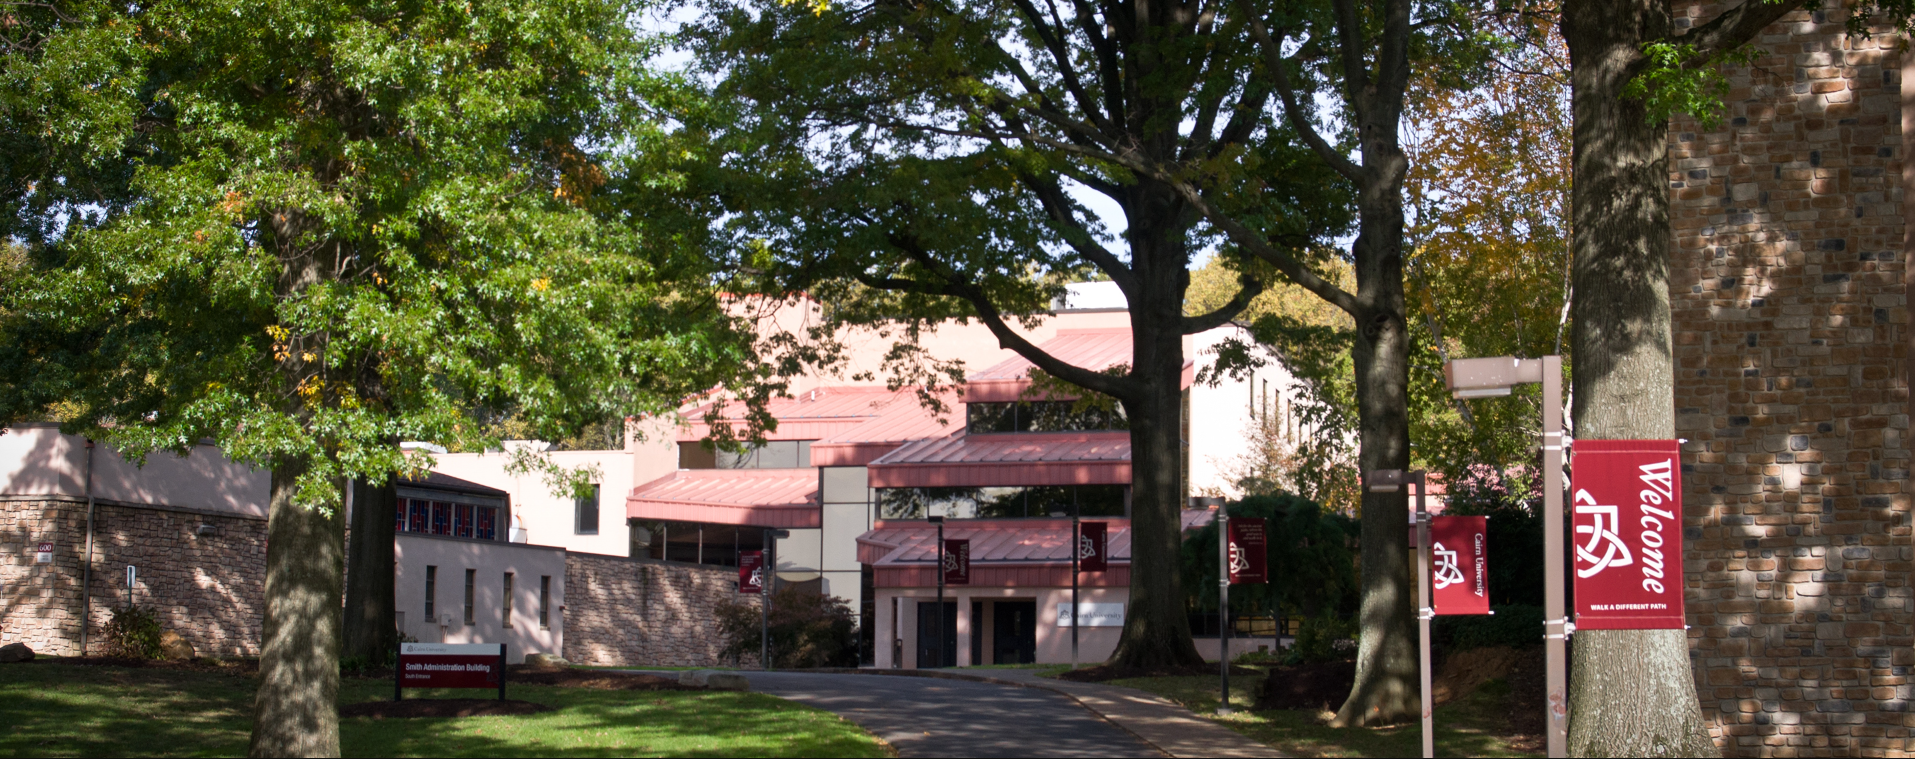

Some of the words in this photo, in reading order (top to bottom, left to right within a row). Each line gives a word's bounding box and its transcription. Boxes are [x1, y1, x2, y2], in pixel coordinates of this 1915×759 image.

[1638, 458, 1675, 594] Welcome
[1475, 533, 1483, 555] Cairn
[1475, 557, 1485, 597] University
[1089, 612, 1122, 620] University
[405, 663, 423, 671] Smith
[423, 663, 465, 672] Administration
[466, 664, 490, 673] Building
